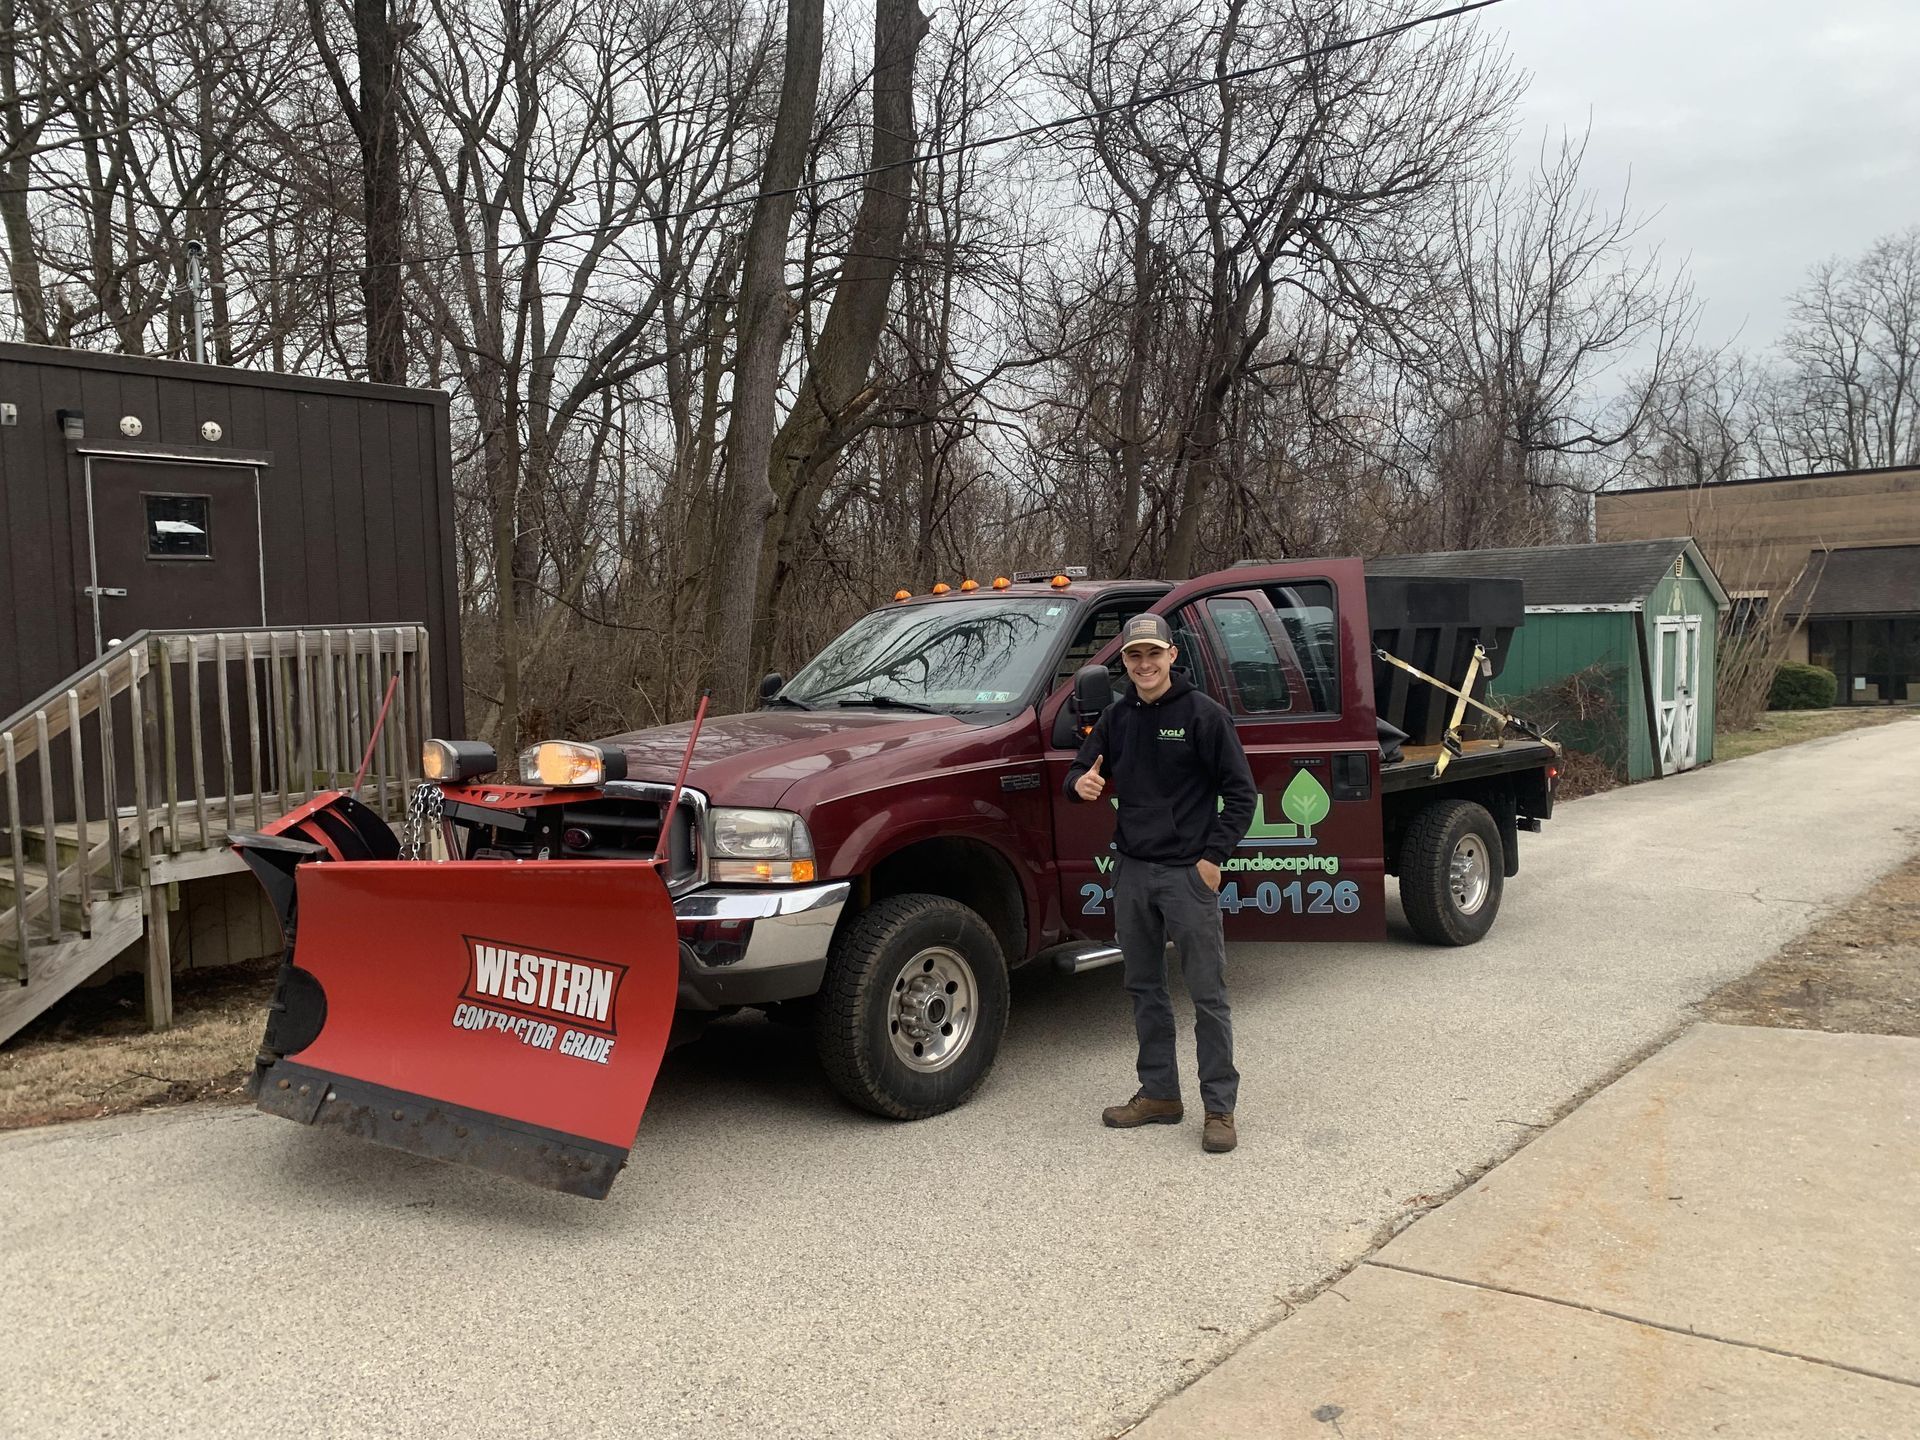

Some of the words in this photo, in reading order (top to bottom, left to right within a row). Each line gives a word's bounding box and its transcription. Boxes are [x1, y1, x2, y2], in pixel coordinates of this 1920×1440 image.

[1159, 729, 1181, 737] VGL
[1219, 851, 1339, 875] Landscaping
[475, 944, 614, 1022] WESTERN
[452, 1003, 558, 1050] CONTRACTOR
[559, 1029, 615, 1064] GRADE
